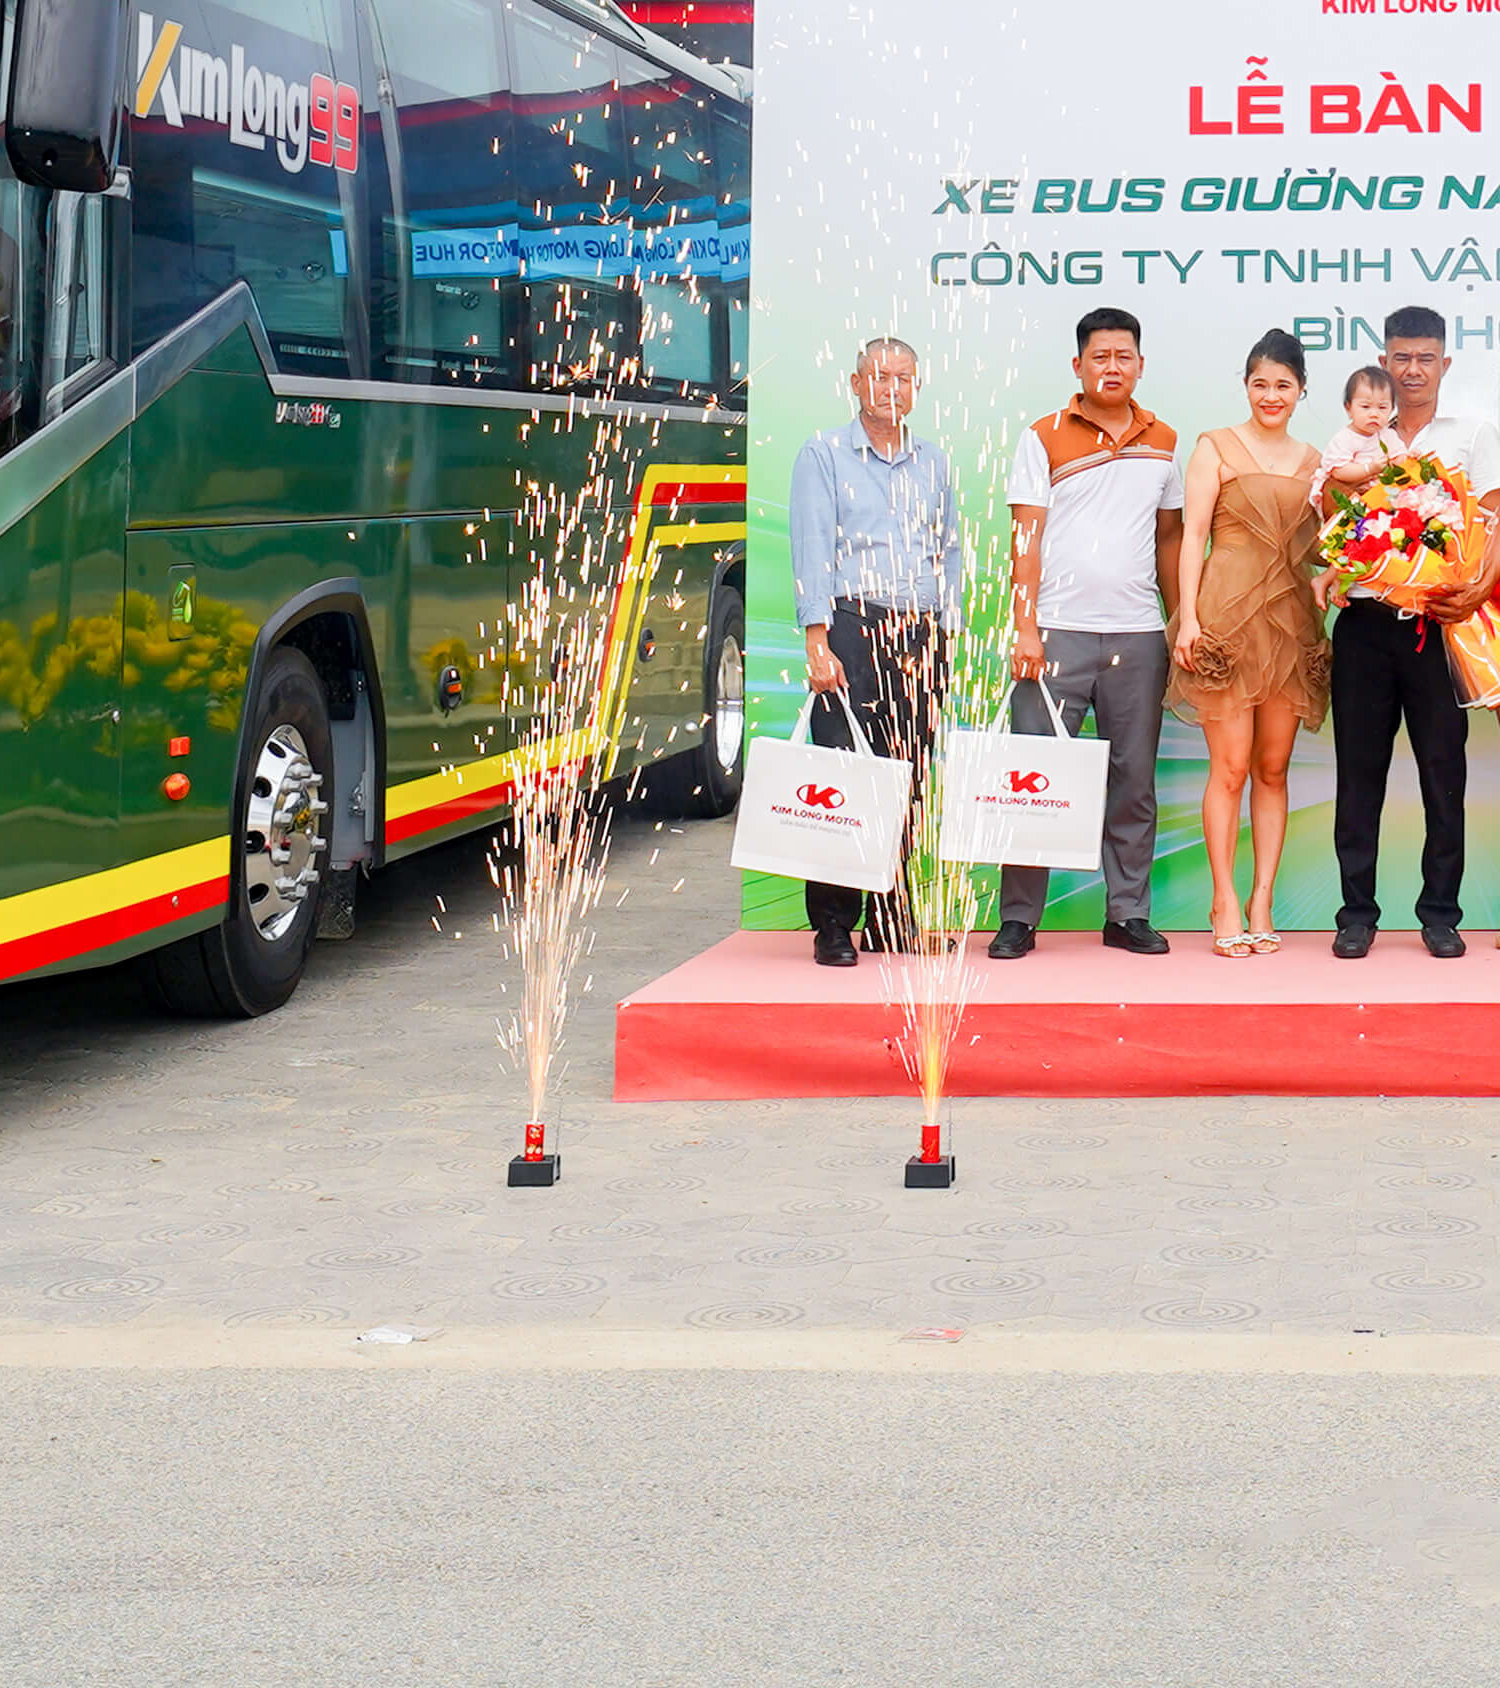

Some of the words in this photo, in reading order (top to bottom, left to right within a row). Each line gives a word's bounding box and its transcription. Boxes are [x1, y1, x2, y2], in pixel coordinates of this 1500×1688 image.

[1187, 51, 1285, 137] LỄ
[1308, 72, 1483, 134] BÀN
[931, 178, 1020, 214] XE
[1032, 178, 1165, 214] BUS
[1181, 166, 1423, 214] GIƯỜNG
[931, 241, 1103, 286] CÔNG
[1122, 249, 1204, 285] TY
[1221, 249, 1394, 284] TNHH
[1293, 305, 1388, 351] BÌN
[771, 805, 792, 816] KIM
[794, 809, 822, 821] LONG
[999, 797, 1029, 807] LONG
[1031, 798, 1071, 810] MOTOR
